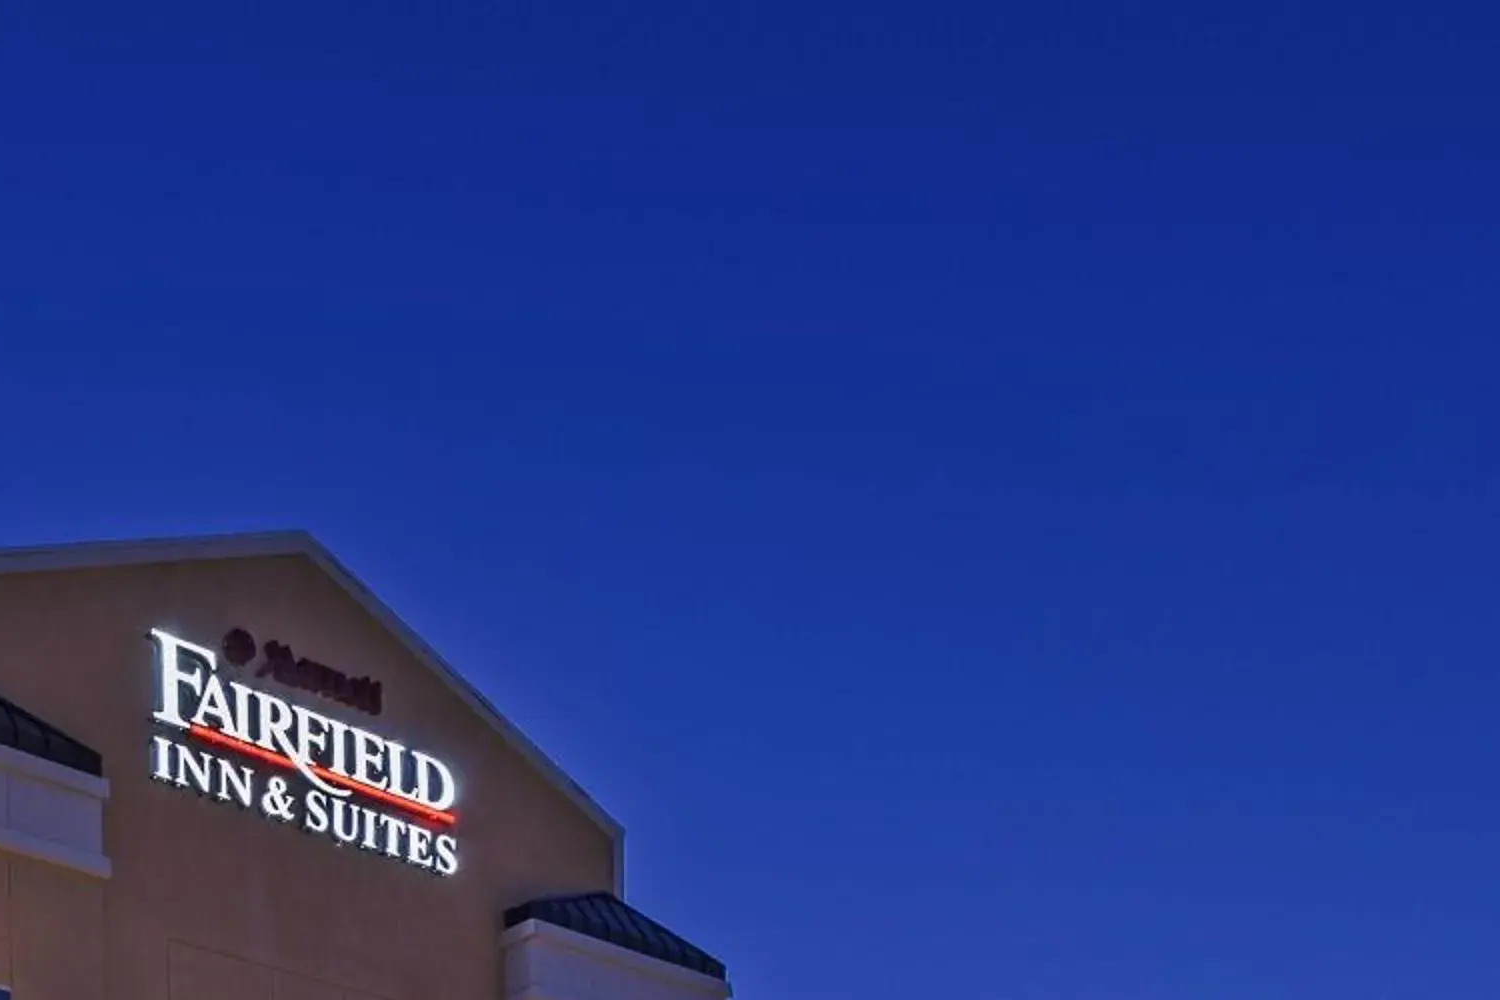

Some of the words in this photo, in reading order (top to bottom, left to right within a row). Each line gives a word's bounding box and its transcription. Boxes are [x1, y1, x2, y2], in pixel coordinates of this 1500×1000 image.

[151, 628, 455, 811] FAIRFIELD
[152, 736, 255, 808] INN
[261, 776, 296, 821] &
[305, 790, 459, 877] SUITES
